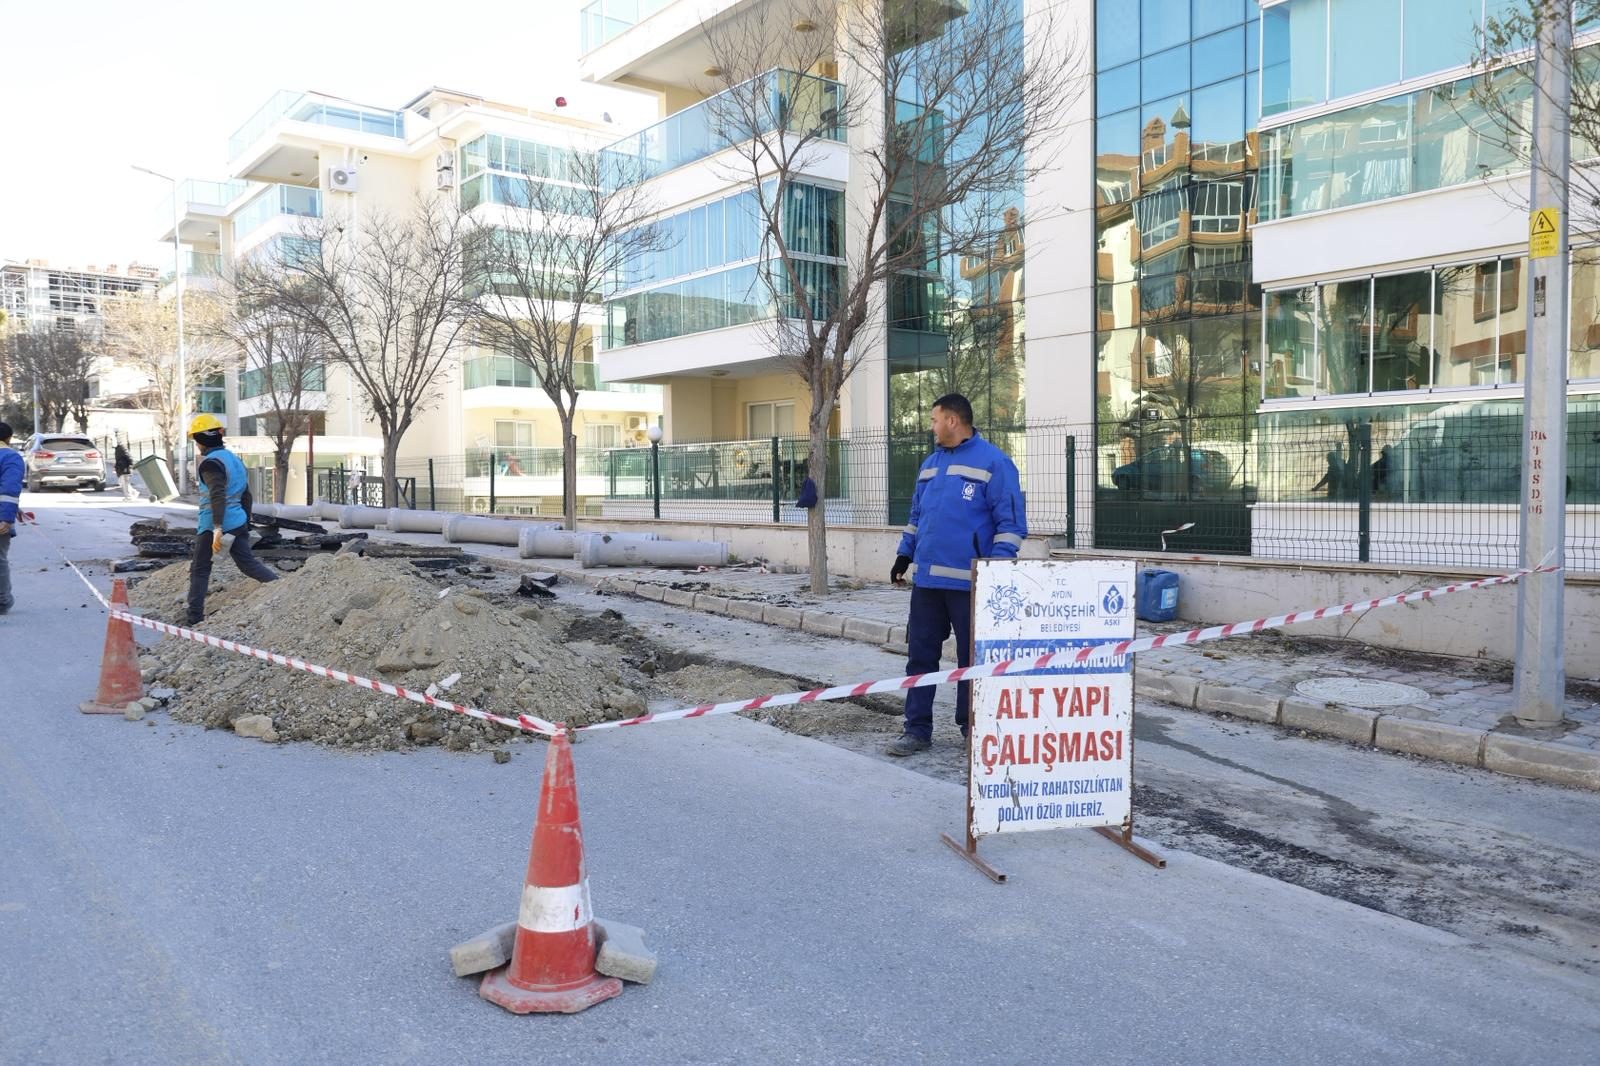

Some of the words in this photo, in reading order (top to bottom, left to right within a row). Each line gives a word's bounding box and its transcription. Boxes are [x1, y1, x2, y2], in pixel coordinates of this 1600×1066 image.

[1051, 590, 1072, 599] AYDIN
[1040, 622, 1081, 633] BELEDİYESİ
[984, 643, 1011, 666] ASKİ
[996, 688, 1044, 720] ALT
[1052, 686, 1110, 717] YAPI
[980, 730, 1122, 775] ÇALIŞMASI
[998, 806, 1033, 822] DOLAYI
[1036, 803, 1062, 820] ÖZÜR
[1065, 800, 1105, 817] DİLERİZ.
